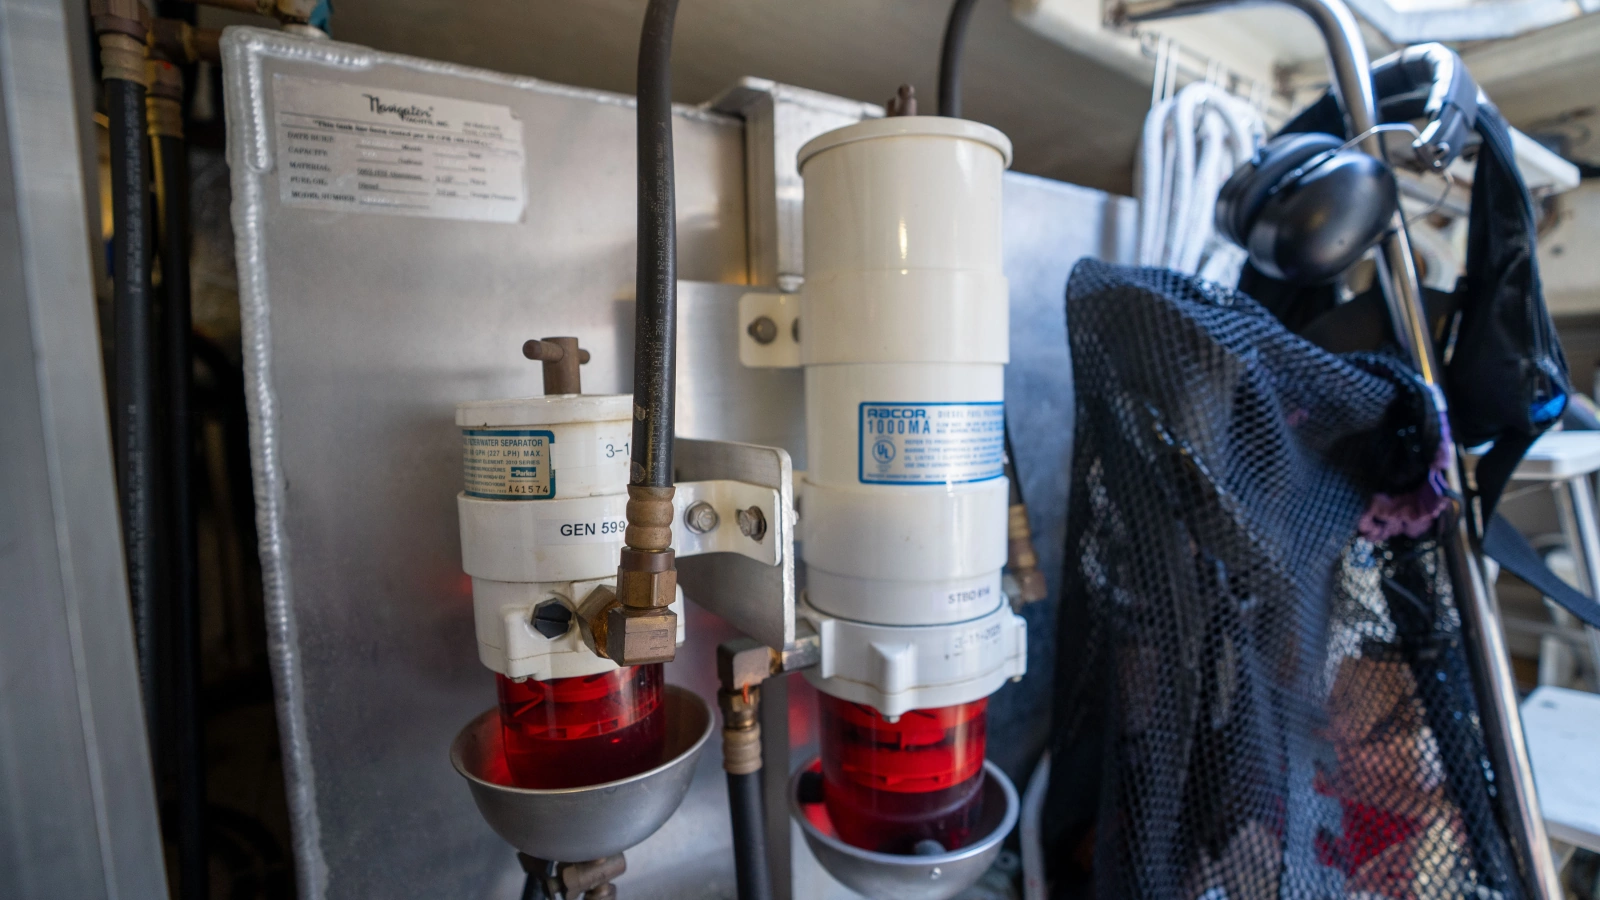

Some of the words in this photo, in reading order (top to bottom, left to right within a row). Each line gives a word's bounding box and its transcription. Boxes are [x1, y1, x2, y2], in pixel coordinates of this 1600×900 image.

[362, 93, 430, 120] Navigator
[661, 415, 668, 426] ID
[868, 420, 930, 434] 1000MA
[651, 402, 660, 456] COMPLIANT
[508, 485, 548, 493] A41574
[560, 523, 595, 536] GEN
[601, 520, 626, 534] 599
